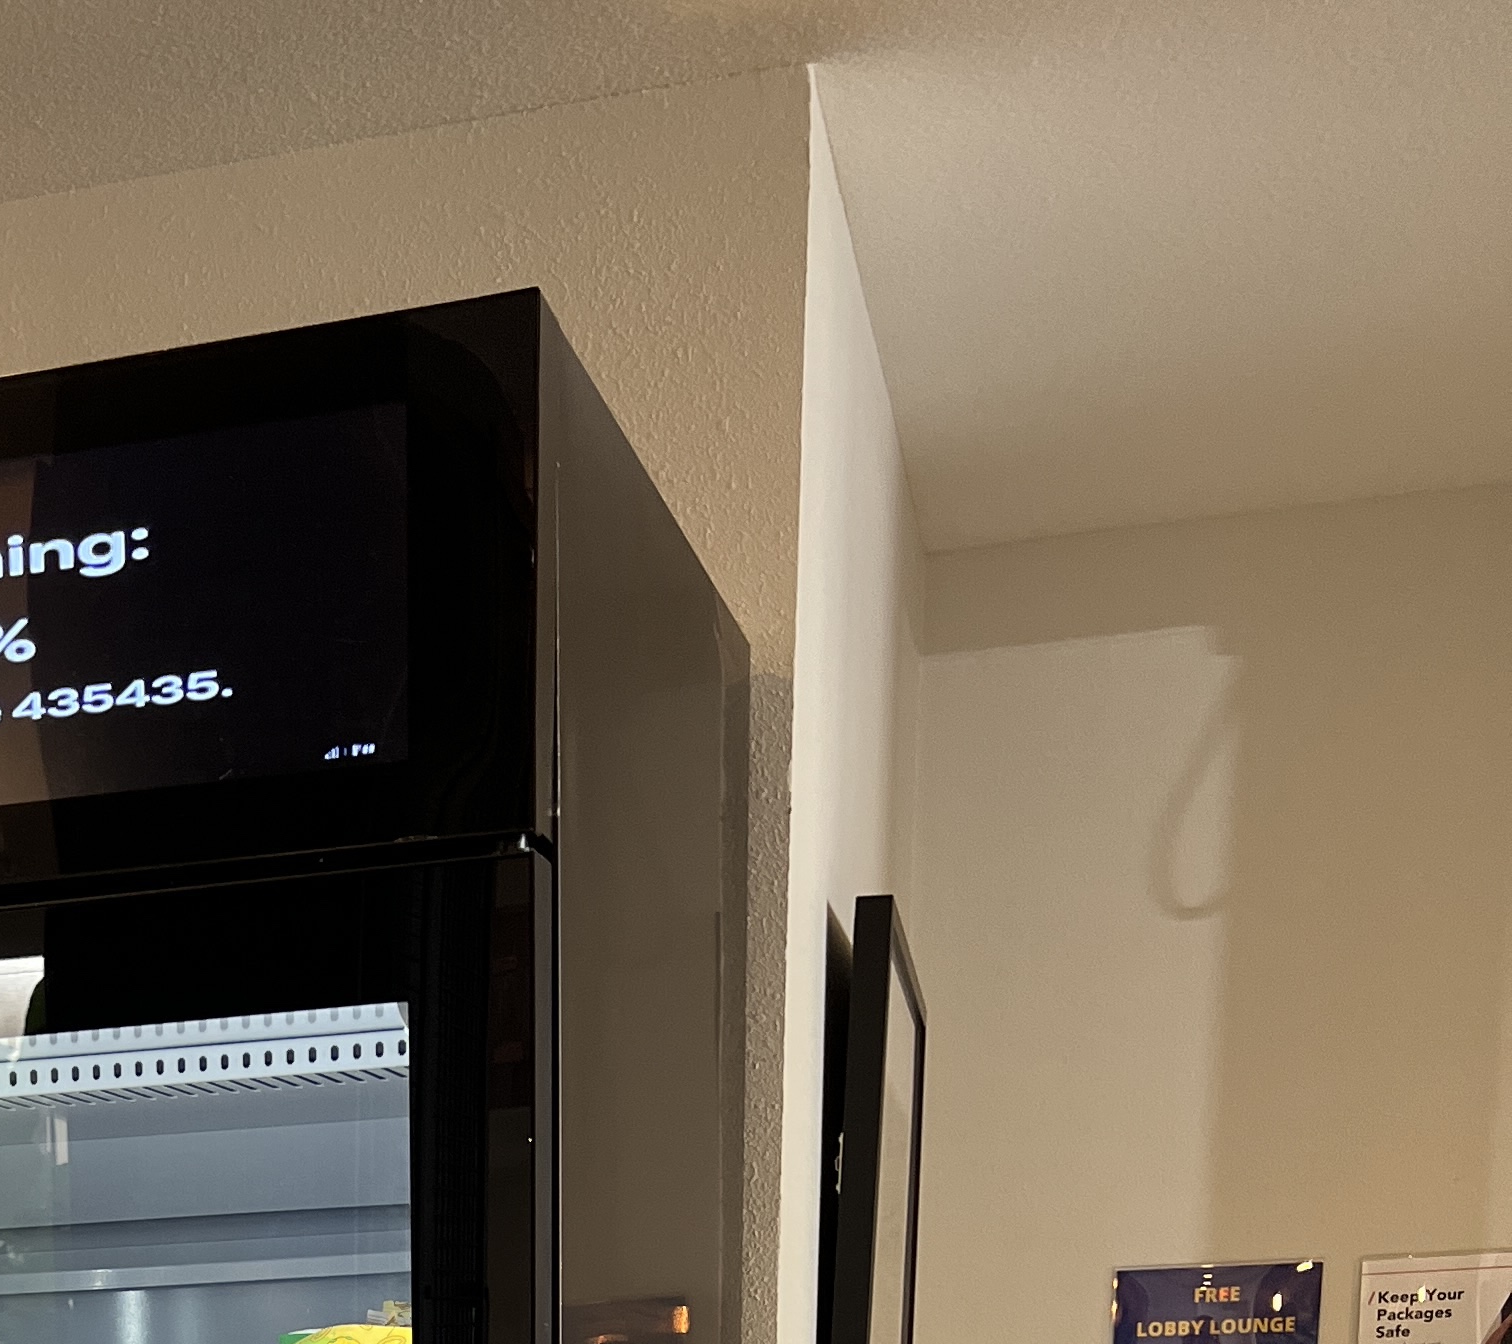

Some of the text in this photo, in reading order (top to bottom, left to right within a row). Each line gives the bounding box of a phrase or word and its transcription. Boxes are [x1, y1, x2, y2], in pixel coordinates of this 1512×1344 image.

[11, 669, 233, 720] 435435.
[1194, 1286, 1241, 1303] FREE
[1378, 1288, 1465, 1307] Keep Your
[1376, 1307, 1453, 1323] Packages
[1136, 1316, 1297, 1338] LOBBY LOUNGE
[1375, 1325, 1411, 1340] Safe
